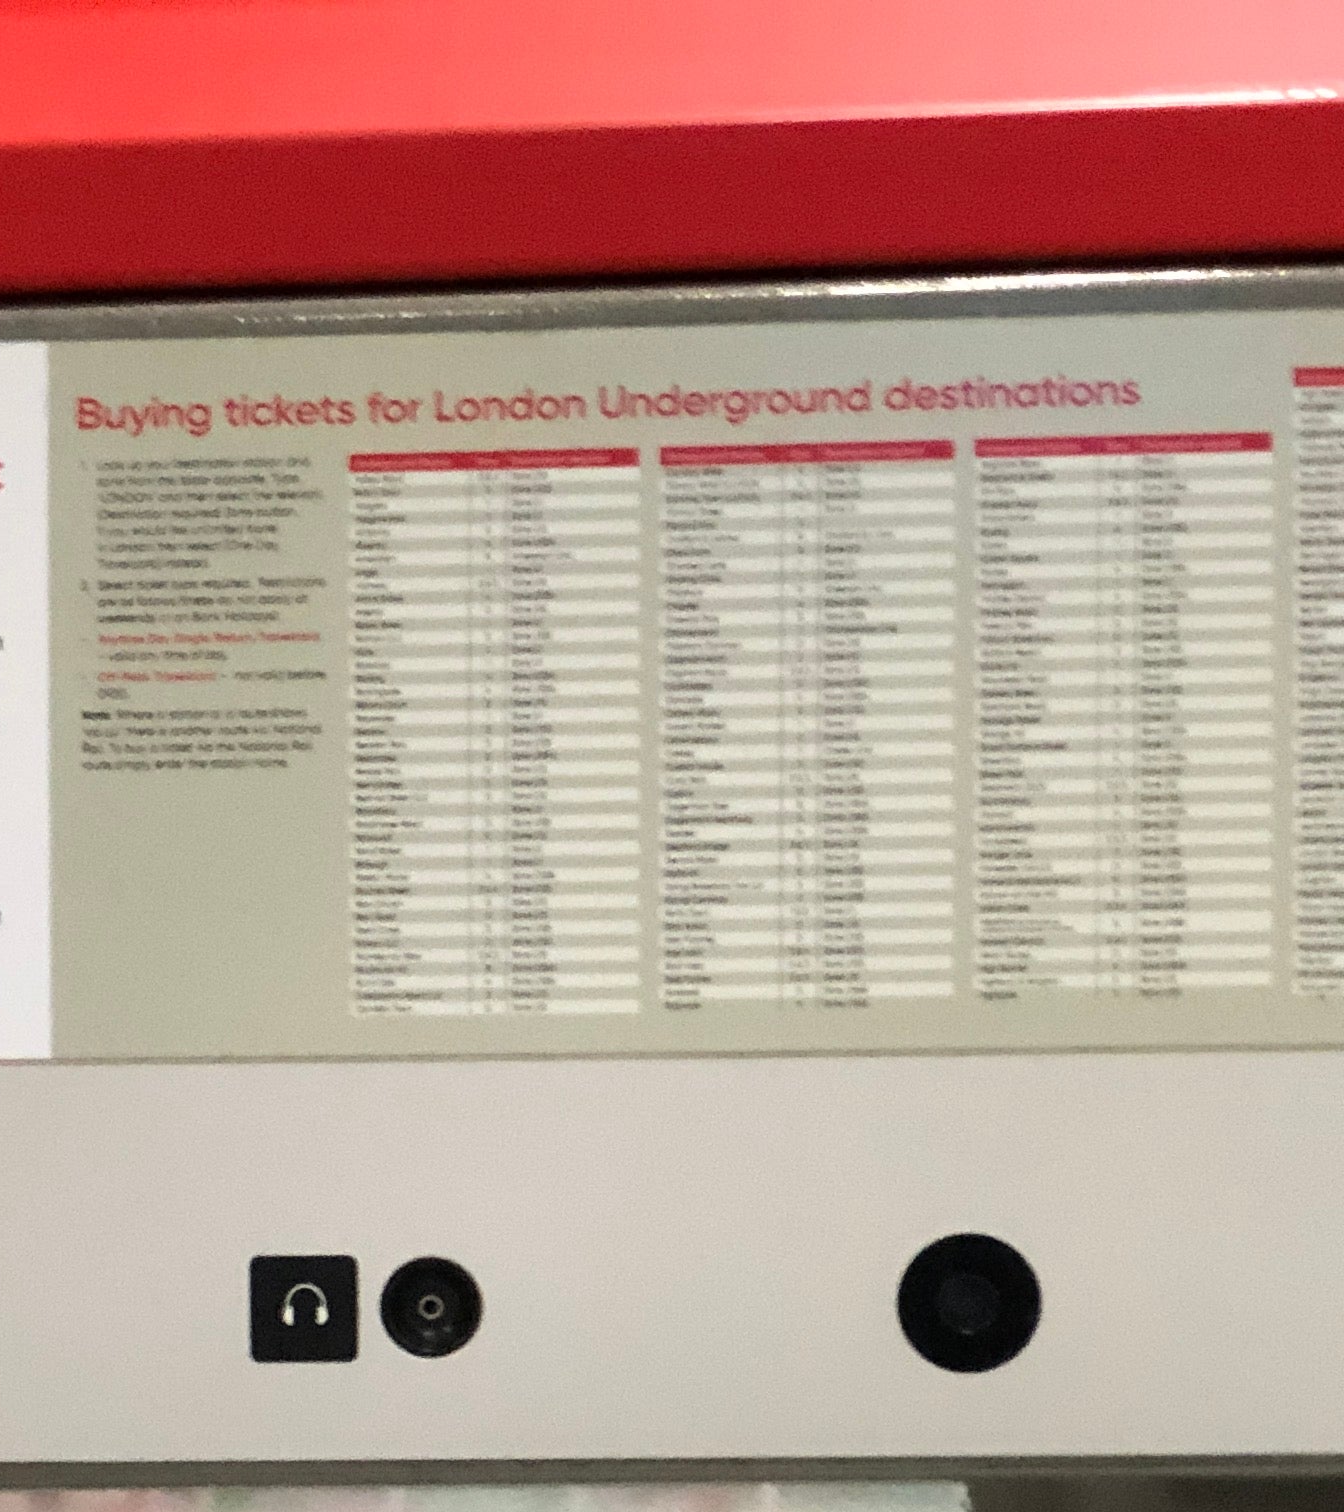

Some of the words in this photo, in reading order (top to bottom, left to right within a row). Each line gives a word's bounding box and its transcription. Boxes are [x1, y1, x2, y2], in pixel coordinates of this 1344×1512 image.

[75, 396, 211, 438] Buying
[223, 394, 357, 429] tickets
[368, 391, 424, 424] for
[432, 387, 587, 424] London
[597, 380, 872, 426] Underground
[882, 373, 1142, 412] destinations
